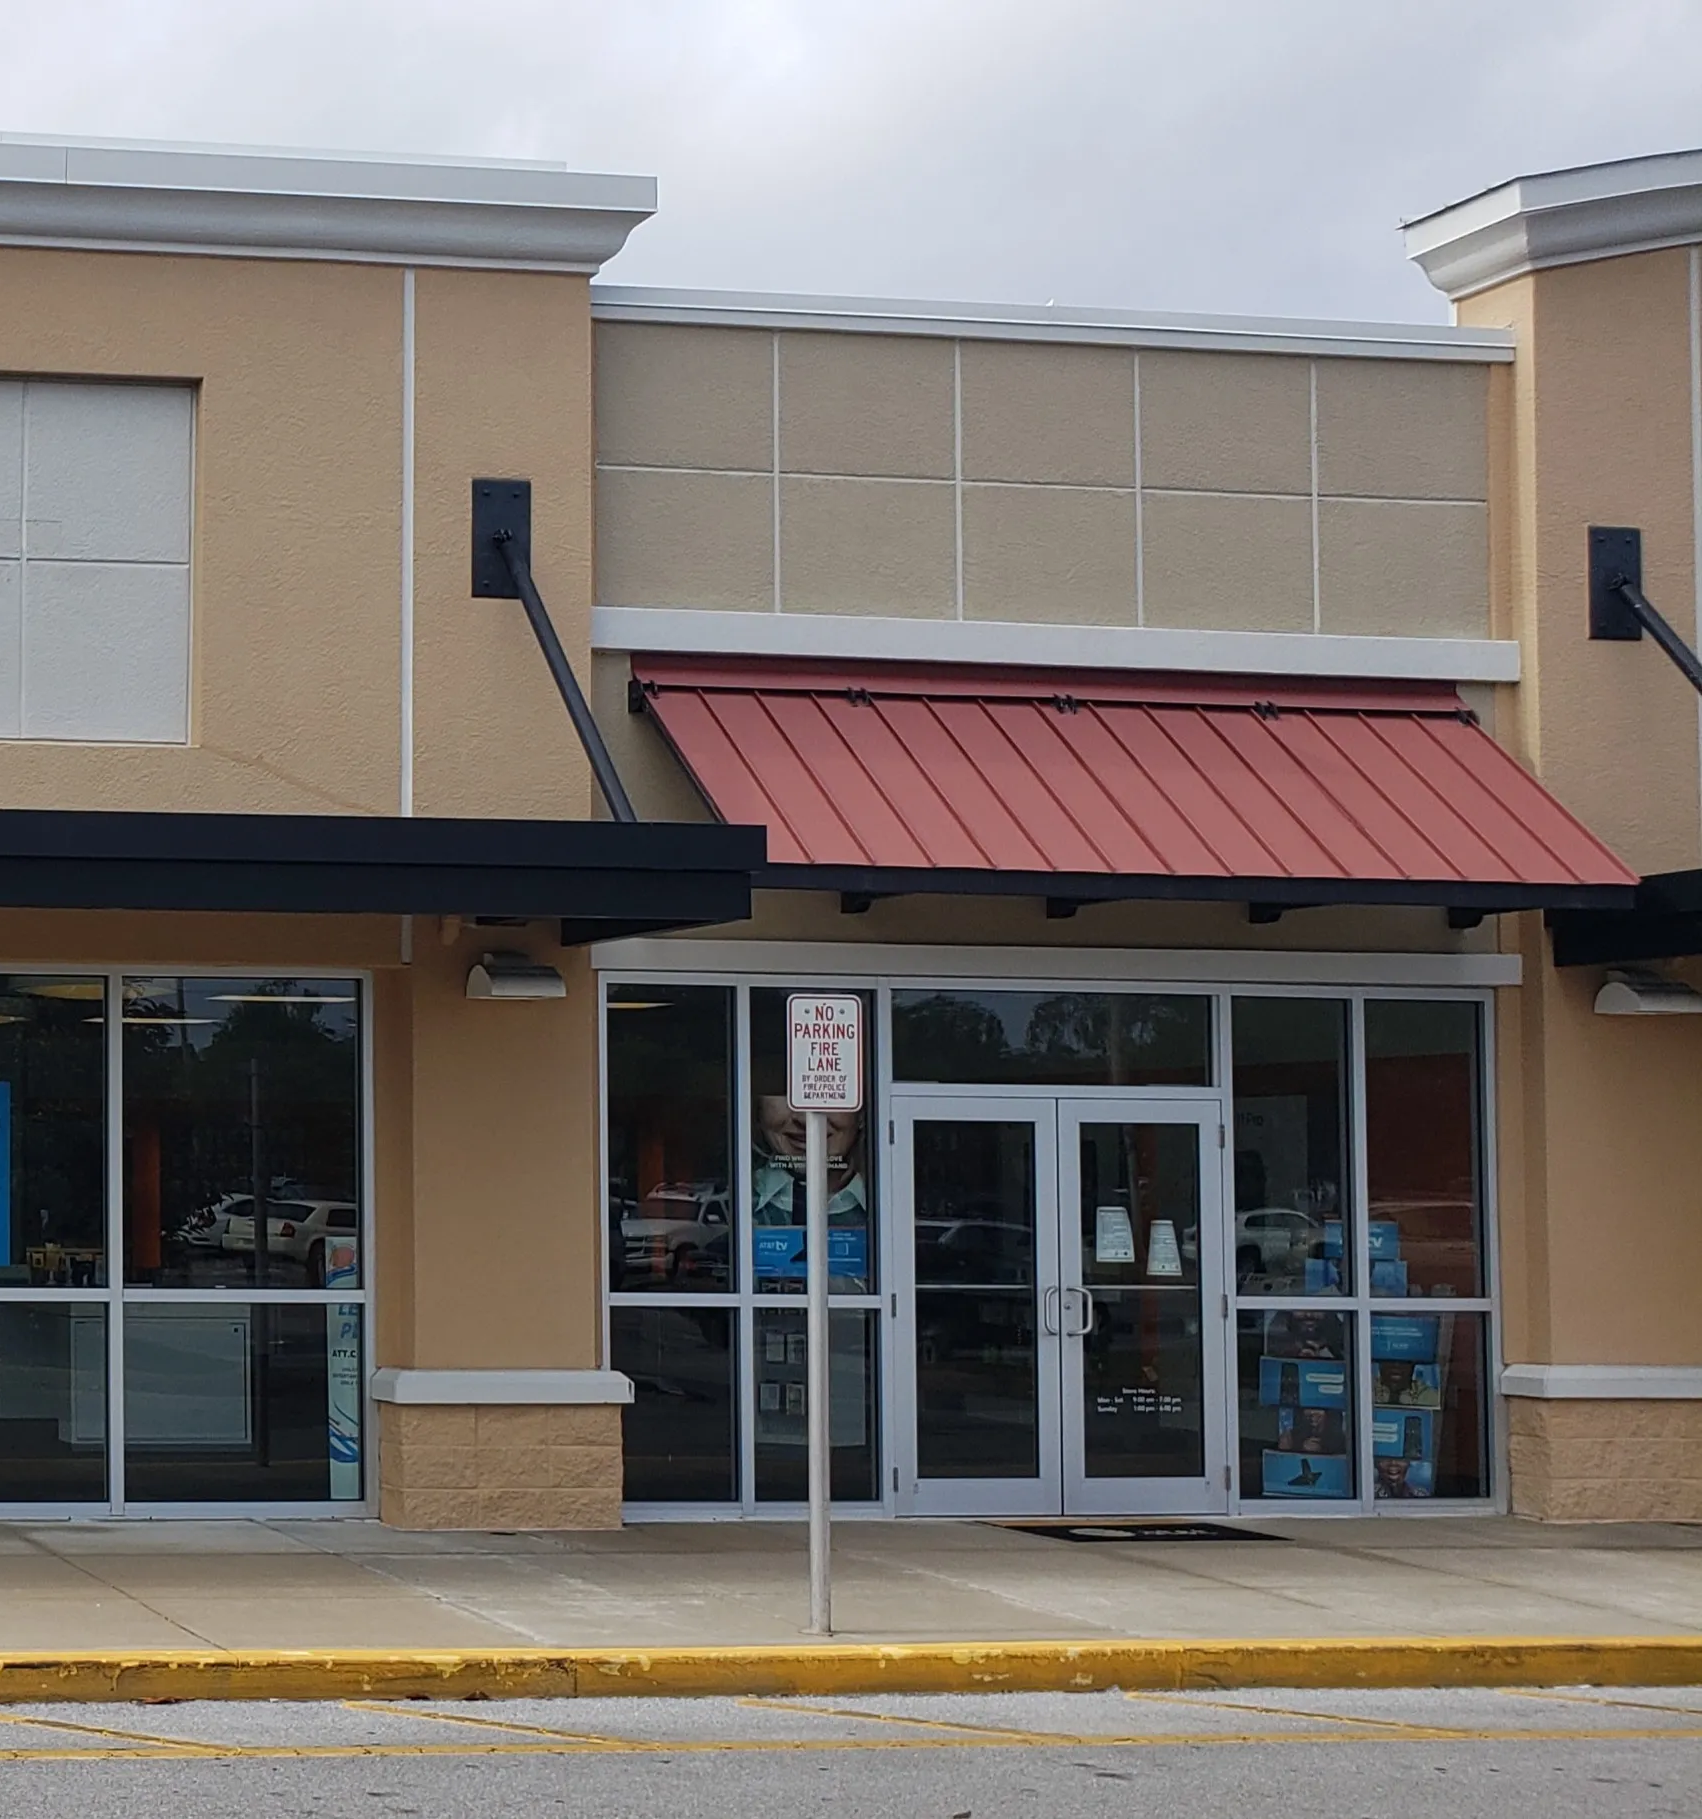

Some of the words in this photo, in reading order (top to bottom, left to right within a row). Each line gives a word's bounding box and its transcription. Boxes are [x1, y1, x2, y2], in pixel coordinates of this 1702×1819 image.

[815, 1006, 834, 1021] NO
[794, 1023, 855, 1040] PARKING
[811, 1042, 839, 1056] FIRE
[808, 1058, 842, 1072] LANE
[802, 1075, 811, 1083] BY
[814, 1075, 836, 1083] ORDER
[839, 1075, 847, 1083] OF
[803, 1083, 846, 1091] FIRE/POLICE
